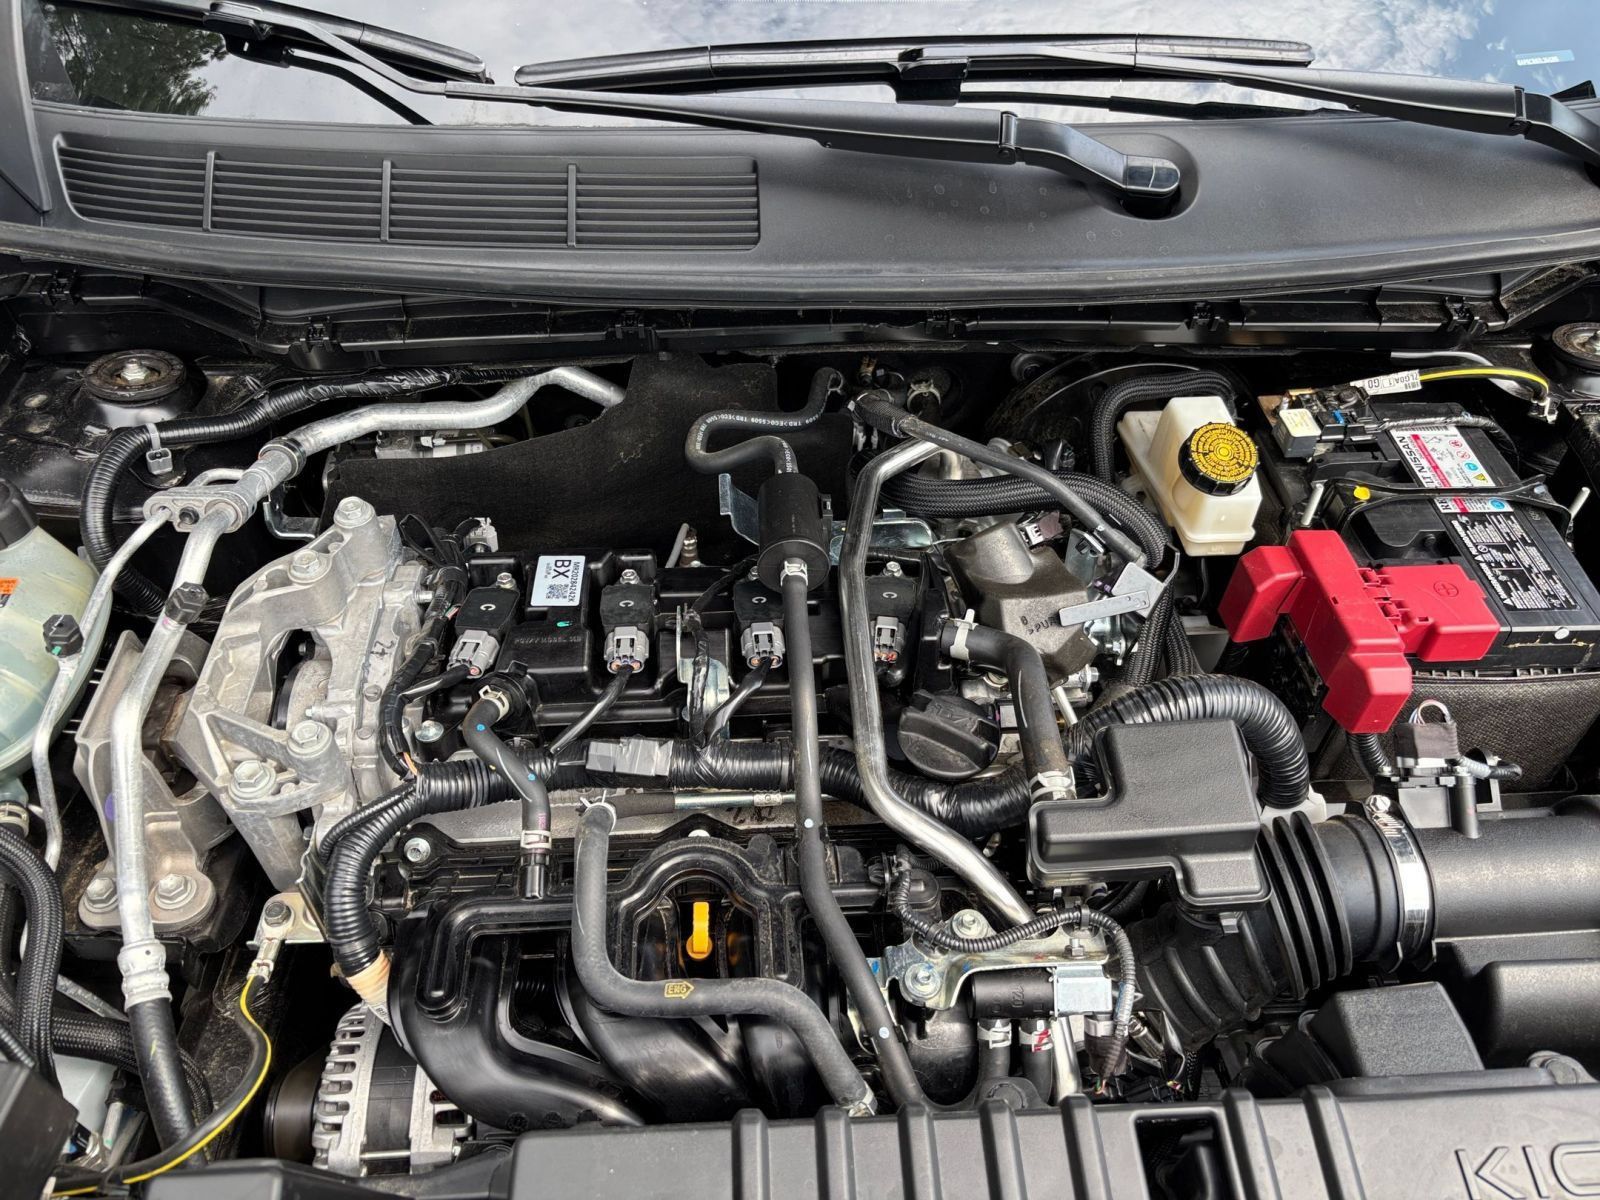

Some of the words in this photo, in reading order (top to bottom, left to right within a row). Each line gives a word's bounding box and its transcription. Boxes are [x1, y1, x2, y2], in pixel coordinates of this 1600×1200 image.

[1396, 436, 1426, 473] NISSAN
[552, 559, 572, 579] BX
[668, 984, 687, 994] ENG
